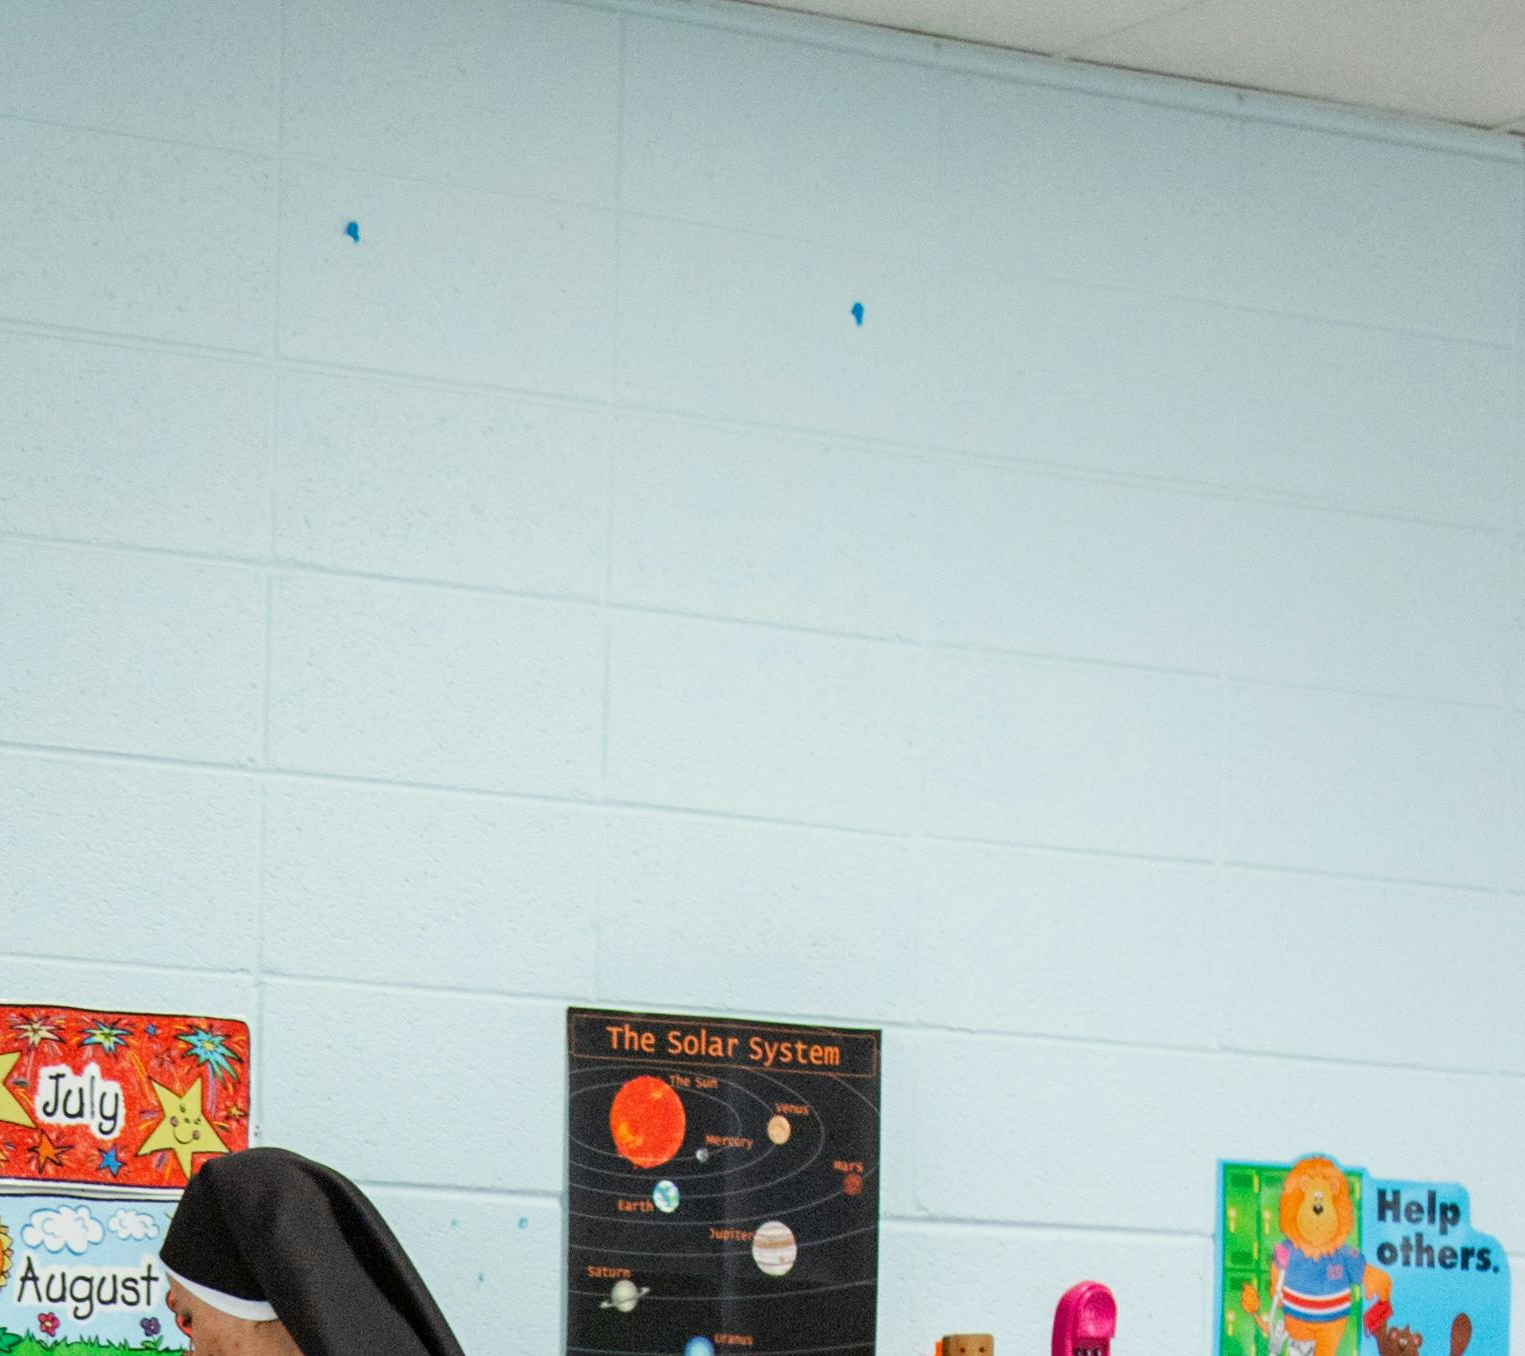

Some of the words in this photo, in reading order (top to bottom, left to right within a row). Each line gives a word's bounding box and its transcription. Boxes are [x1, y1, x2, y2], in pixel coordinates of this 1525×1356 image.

[607, 1025, 655, 1053] The
[668, 1029, 739, 1057] Solar
[749, 1036, 840, 1066] System
[41, 1073, 121, 1131] July
[1377, 1189, 1460, 1235] Help
[1377, 1233, 1499, 1273] others.
[18, 1256, 160, 1323] August
